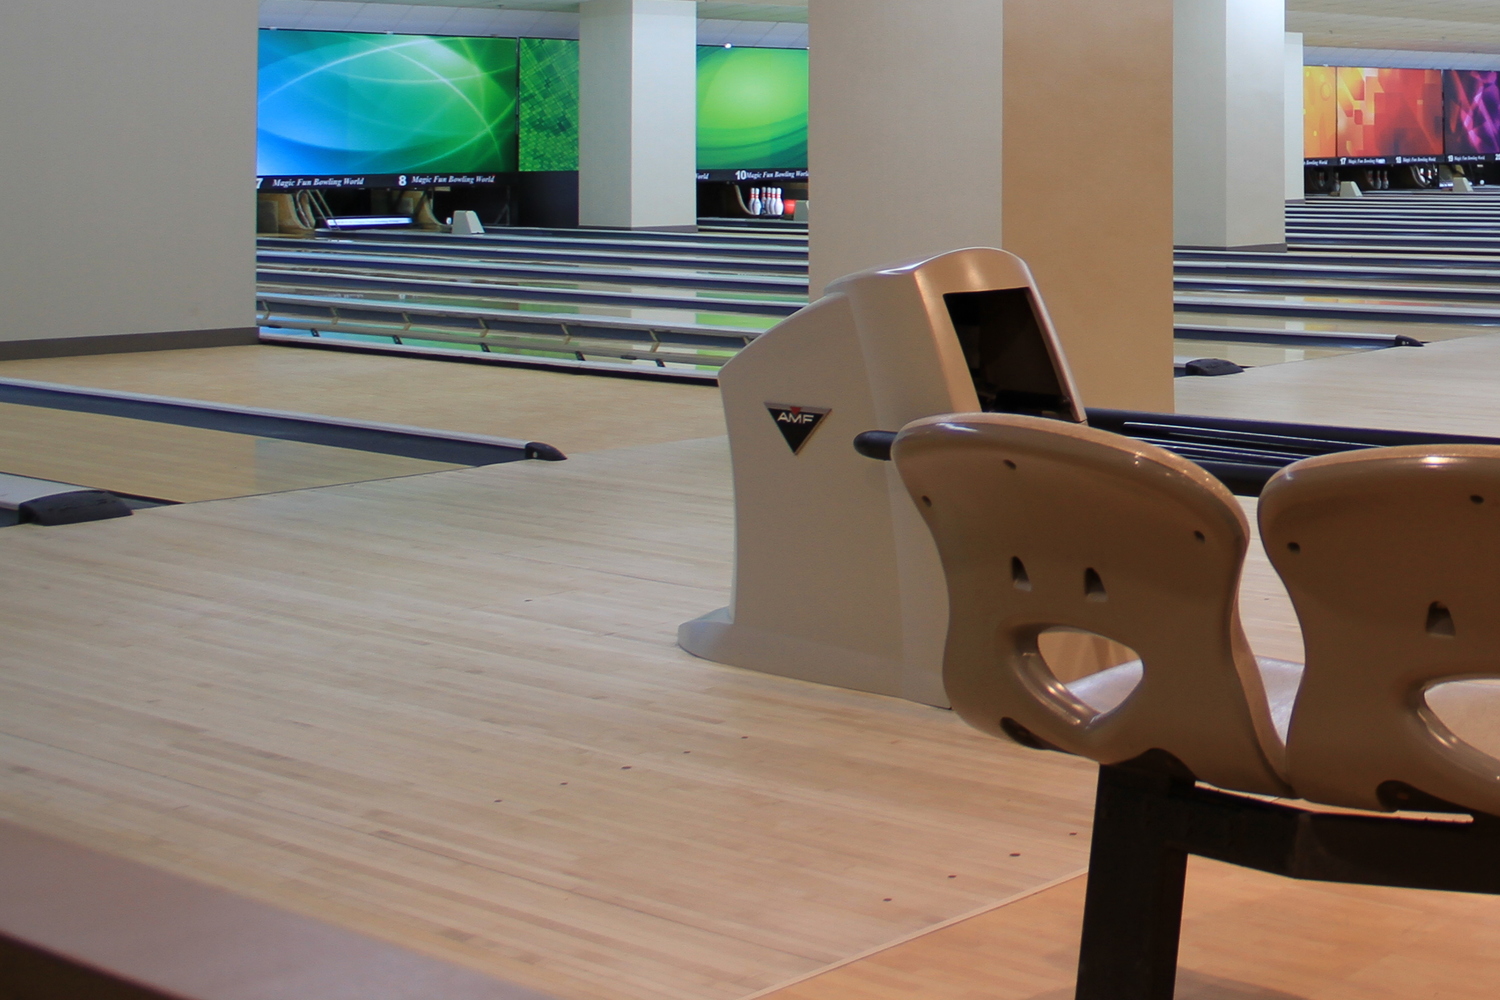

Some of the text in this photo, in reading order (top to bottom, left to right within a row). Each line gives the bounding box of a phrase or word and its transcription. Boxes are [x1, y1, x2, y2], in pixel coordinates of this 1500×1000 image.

[398, 175, 407, 186] 8
[411, 176, 432, 185] Magic
[448, 175, 474, 184] Bowling
[476, 175, 495, 183] World
[735, 170, 747, 180] 10
[255, 177, 364, 189] 7 Magic Fun Bowling World
[777, 411, 814, 424] AMF
